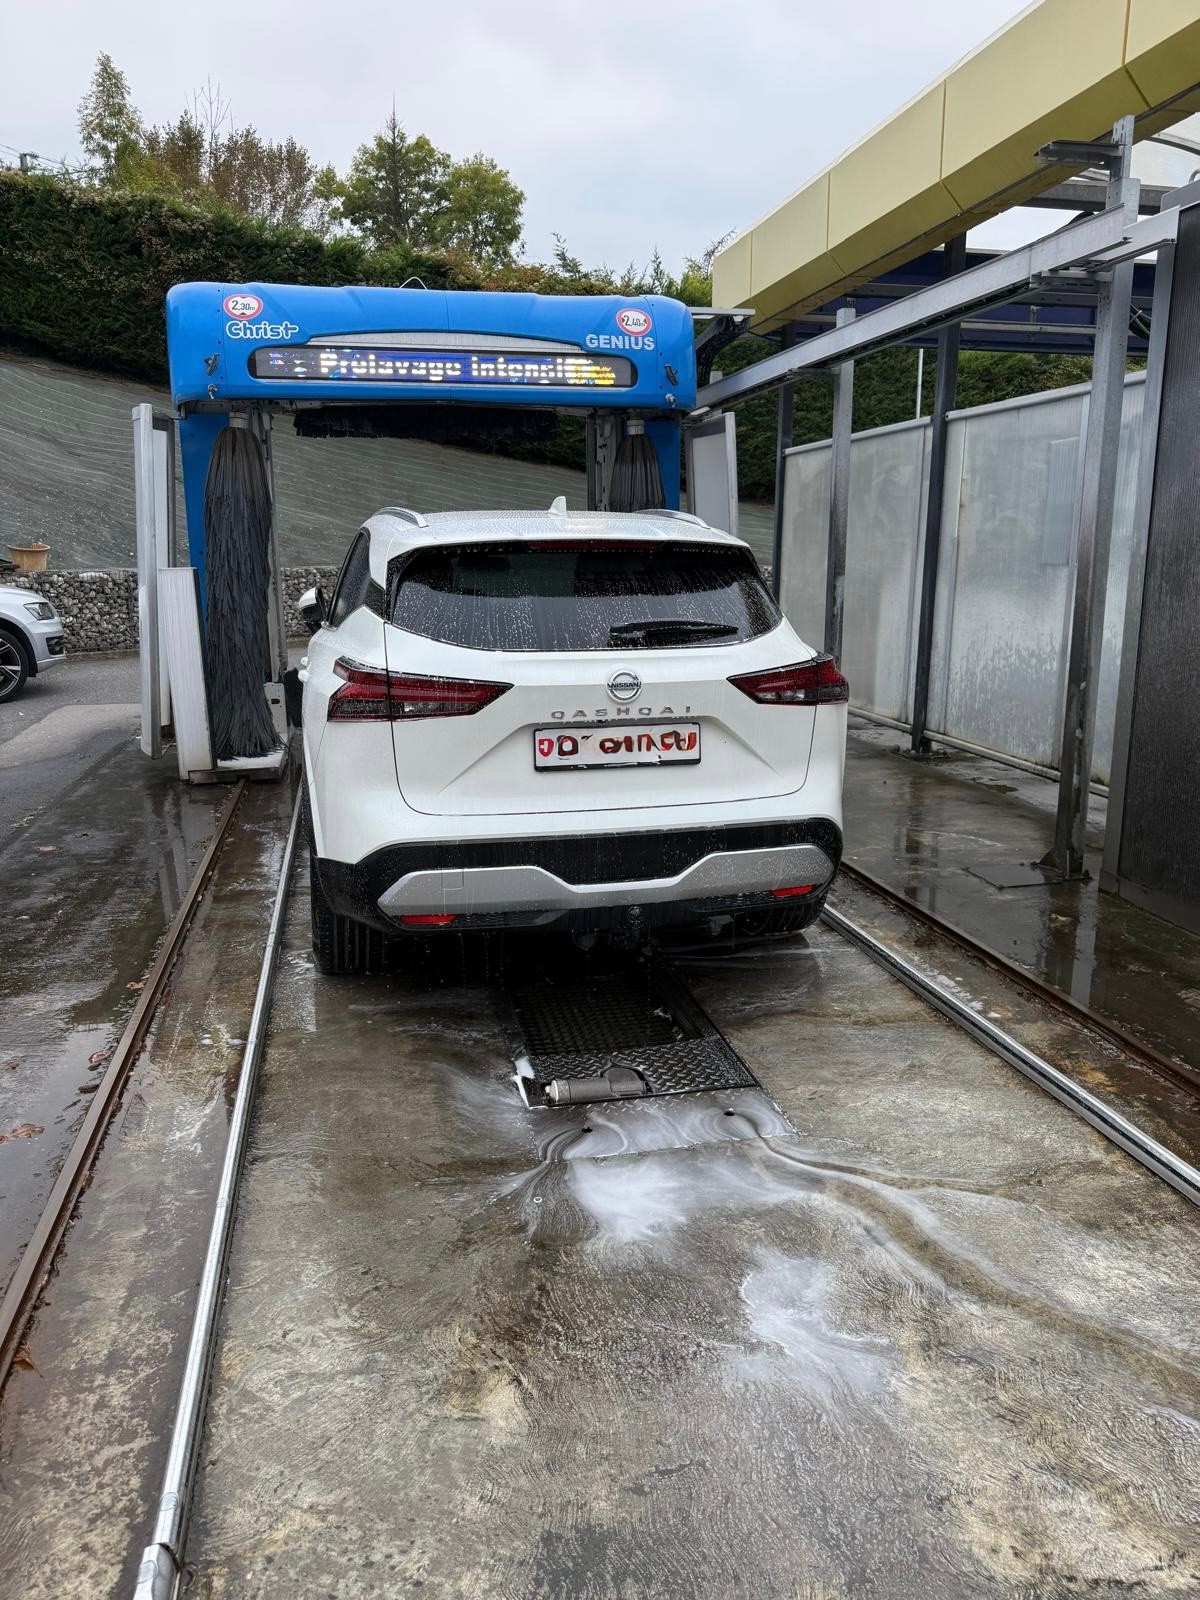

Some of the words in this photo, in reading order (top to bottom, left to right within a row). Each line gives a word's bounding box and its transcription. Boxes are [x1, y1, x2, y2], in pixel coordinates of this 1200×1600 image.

[225, 320, 299, 339] Christ
[585, 333, 655, 350] GENIUS
[551, 705, 691, 720] QASHQAI
